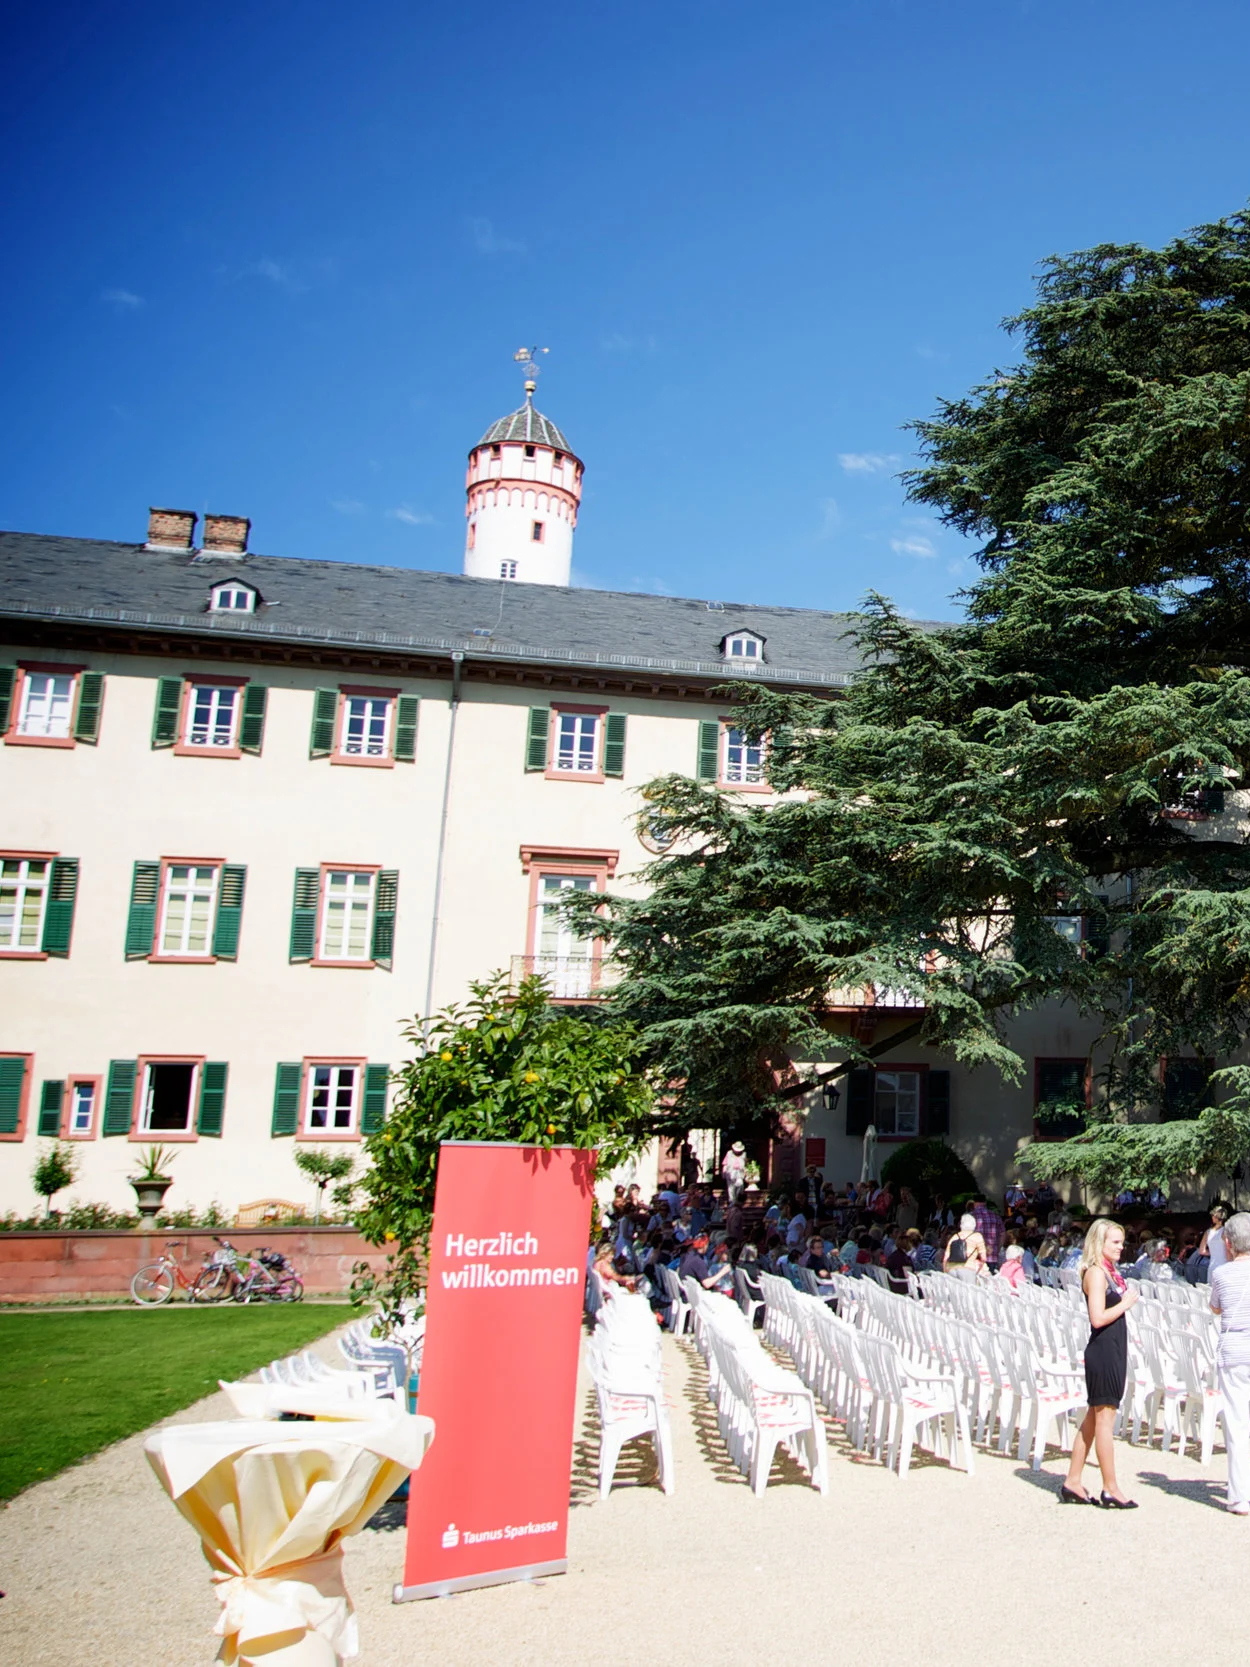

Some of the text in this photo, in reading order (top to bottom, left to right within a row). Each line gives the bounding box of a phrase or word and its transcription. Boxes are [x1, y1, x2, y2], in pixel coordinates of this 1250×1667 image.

[445, 1232, 538, 1257] Herzlich
[441, 1264, 579, 1289] willkommen
[462, 1521, 558, 1545] Taunus Sparkasse
